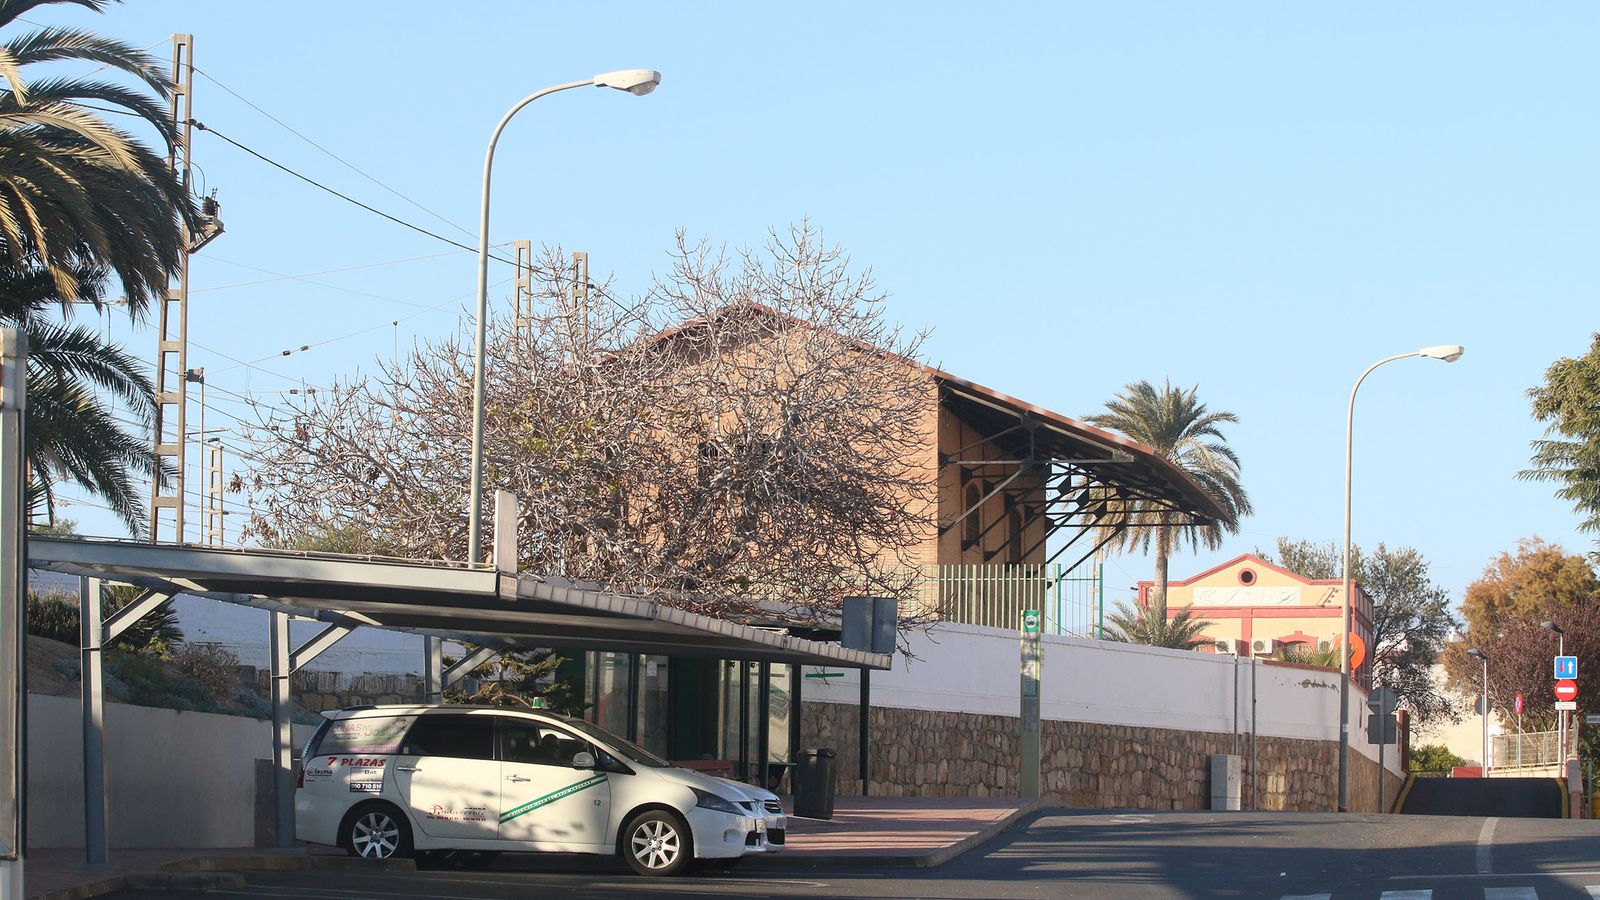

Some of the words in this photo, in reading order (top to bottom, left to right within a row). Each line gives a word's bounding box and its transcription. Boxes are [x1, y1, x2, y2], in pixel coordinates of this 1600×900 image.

[328, 757, 337, 766] 7
[340, 757, 386, 767] PLAZAS
[592, 799, 602, 807] 12
